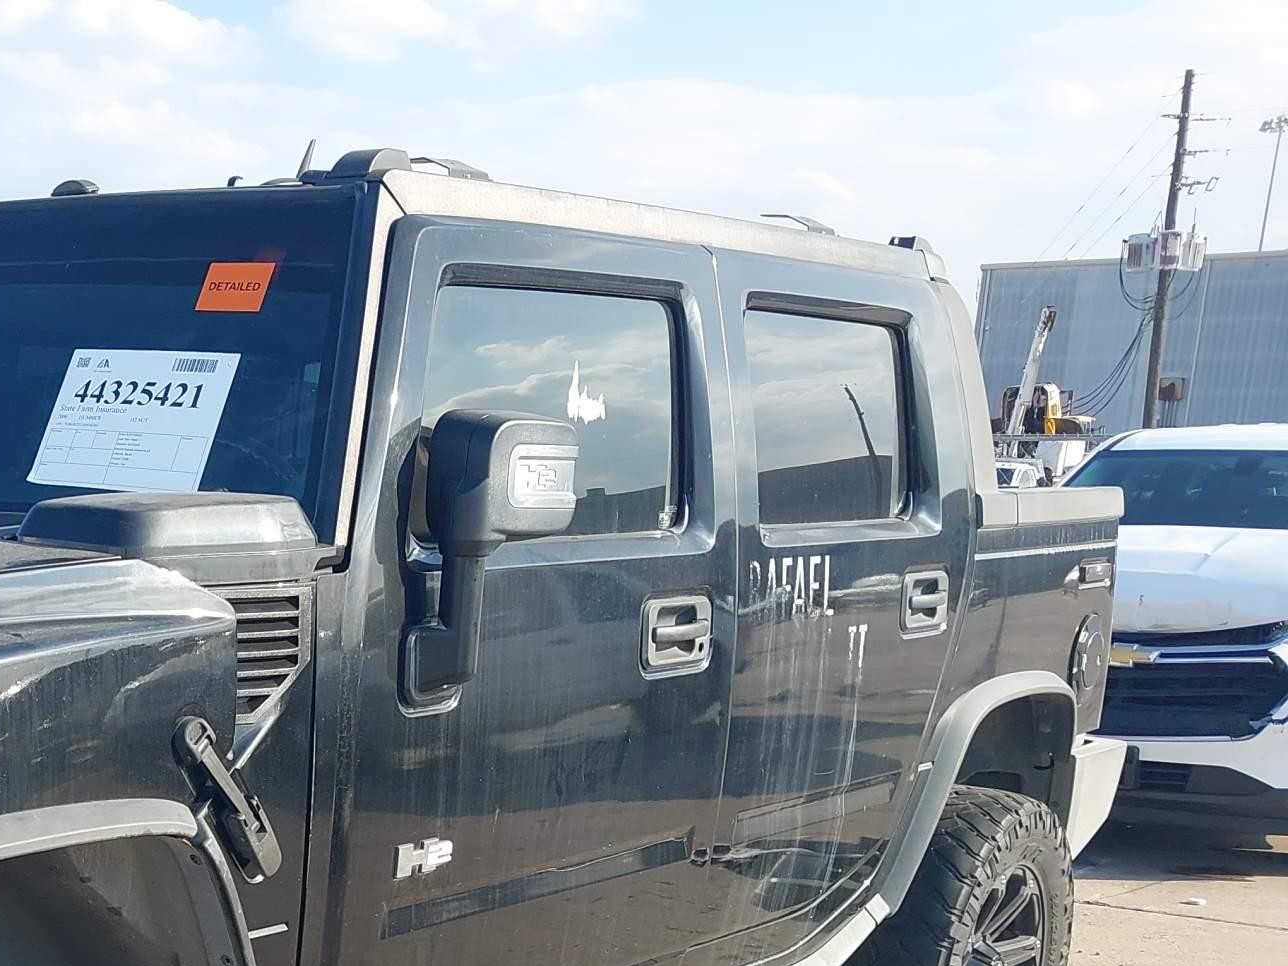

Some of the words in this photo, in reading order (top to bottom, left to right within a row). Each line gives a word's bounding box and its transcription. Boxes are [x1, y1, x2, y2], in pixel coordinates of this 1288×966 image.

[208, 281, 261, 291] DETAILED
[74, 379, 204, 409] 44325421
[59, 404, 76, 412] State
[95, 405, 128, 414] Insurance
[393, 837, 453, 880] H2
